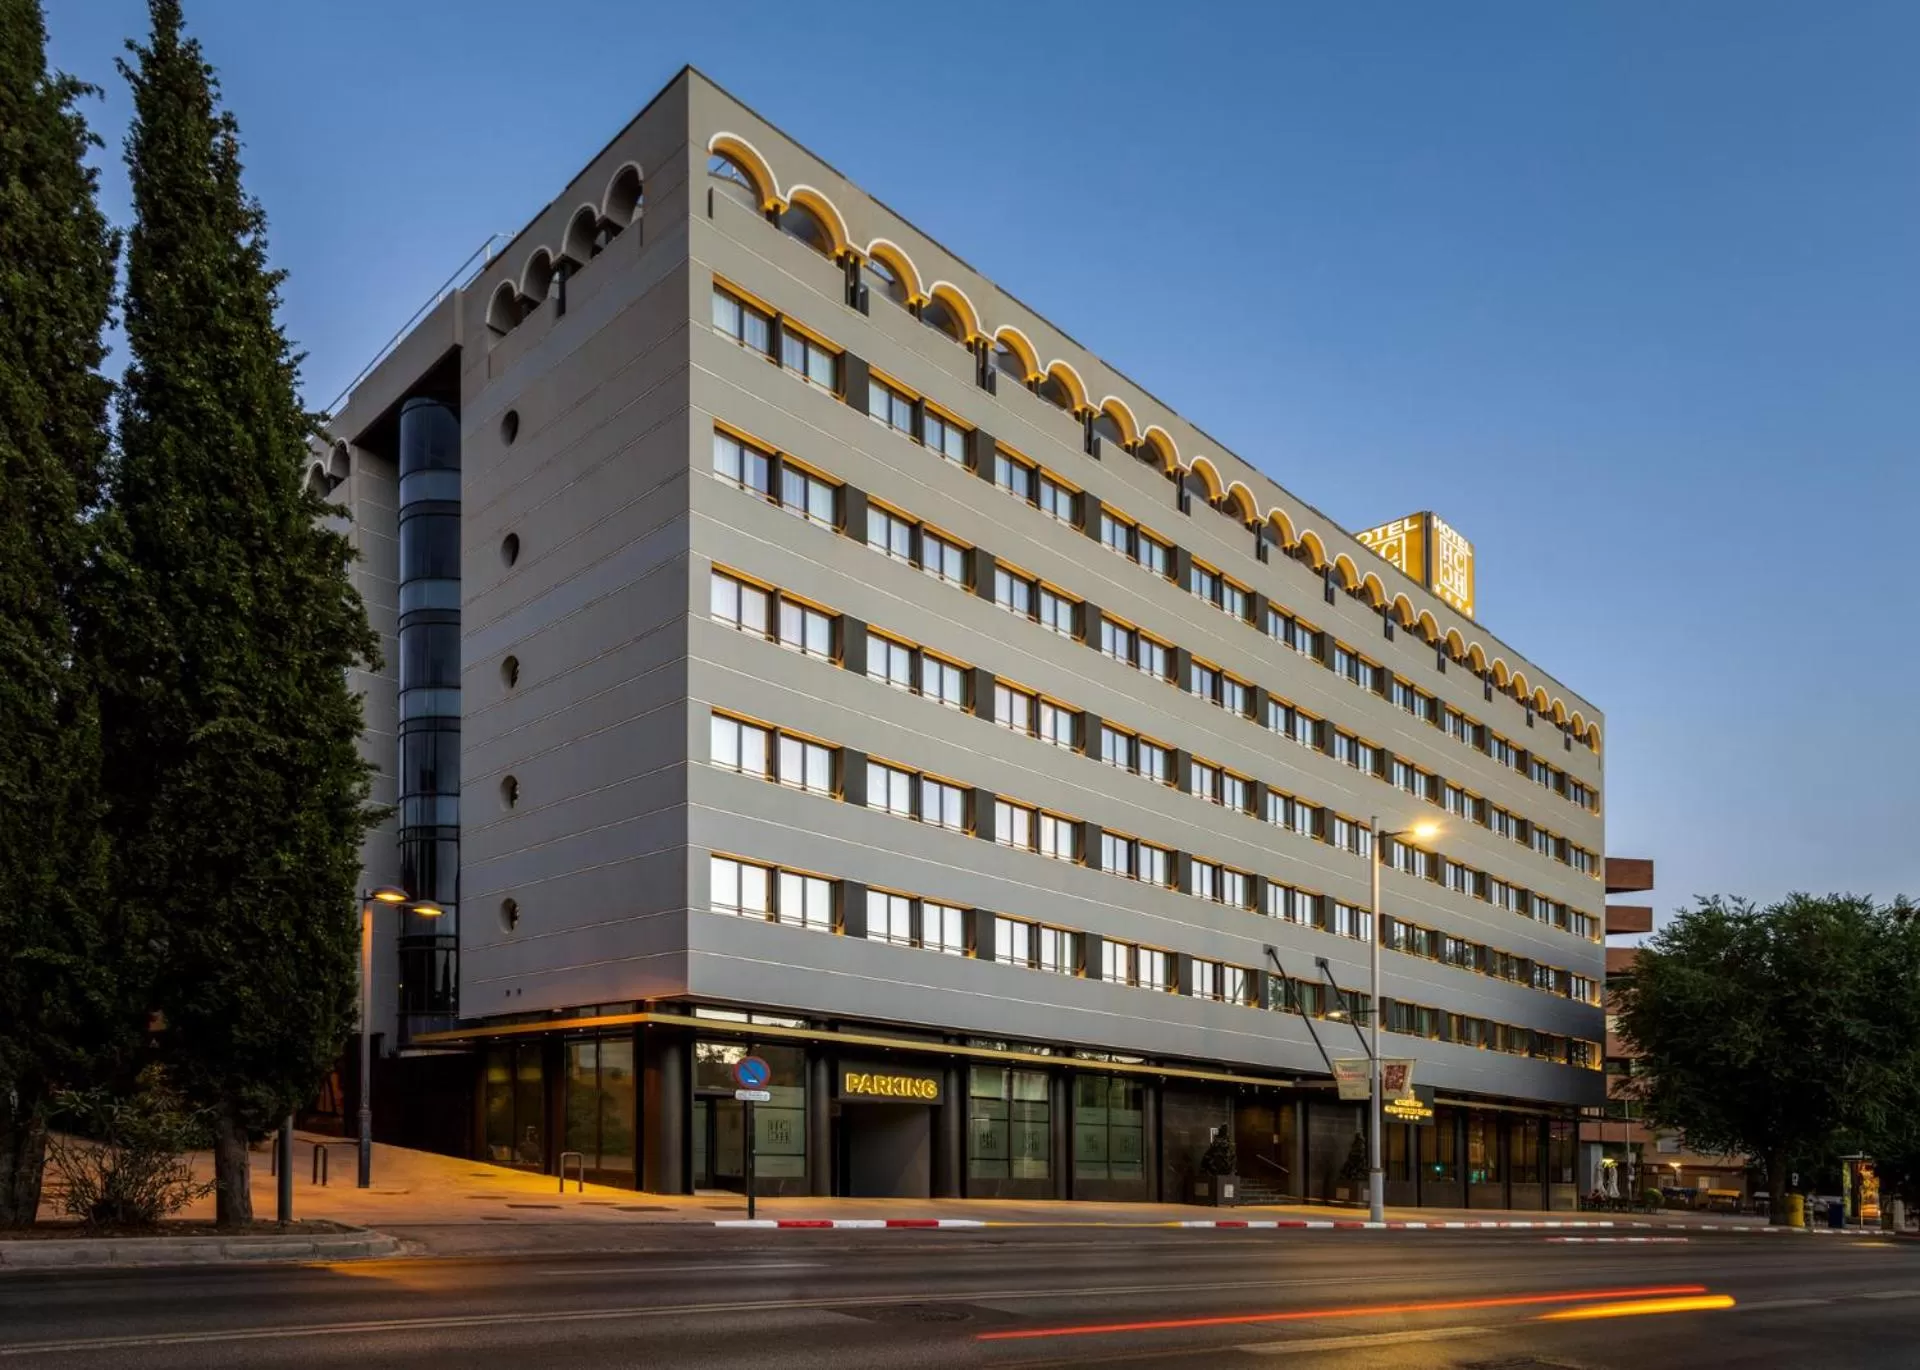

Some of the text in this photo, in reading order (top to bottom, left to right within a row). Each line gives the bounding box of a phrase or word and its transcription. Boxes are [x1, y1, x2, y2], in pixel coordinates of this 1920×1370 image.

[1356, 518, 1418, 546] OTEL
[1433, 516, 1472, 557] HOTEL
[845, 1073, 938, 1099] PARKING
